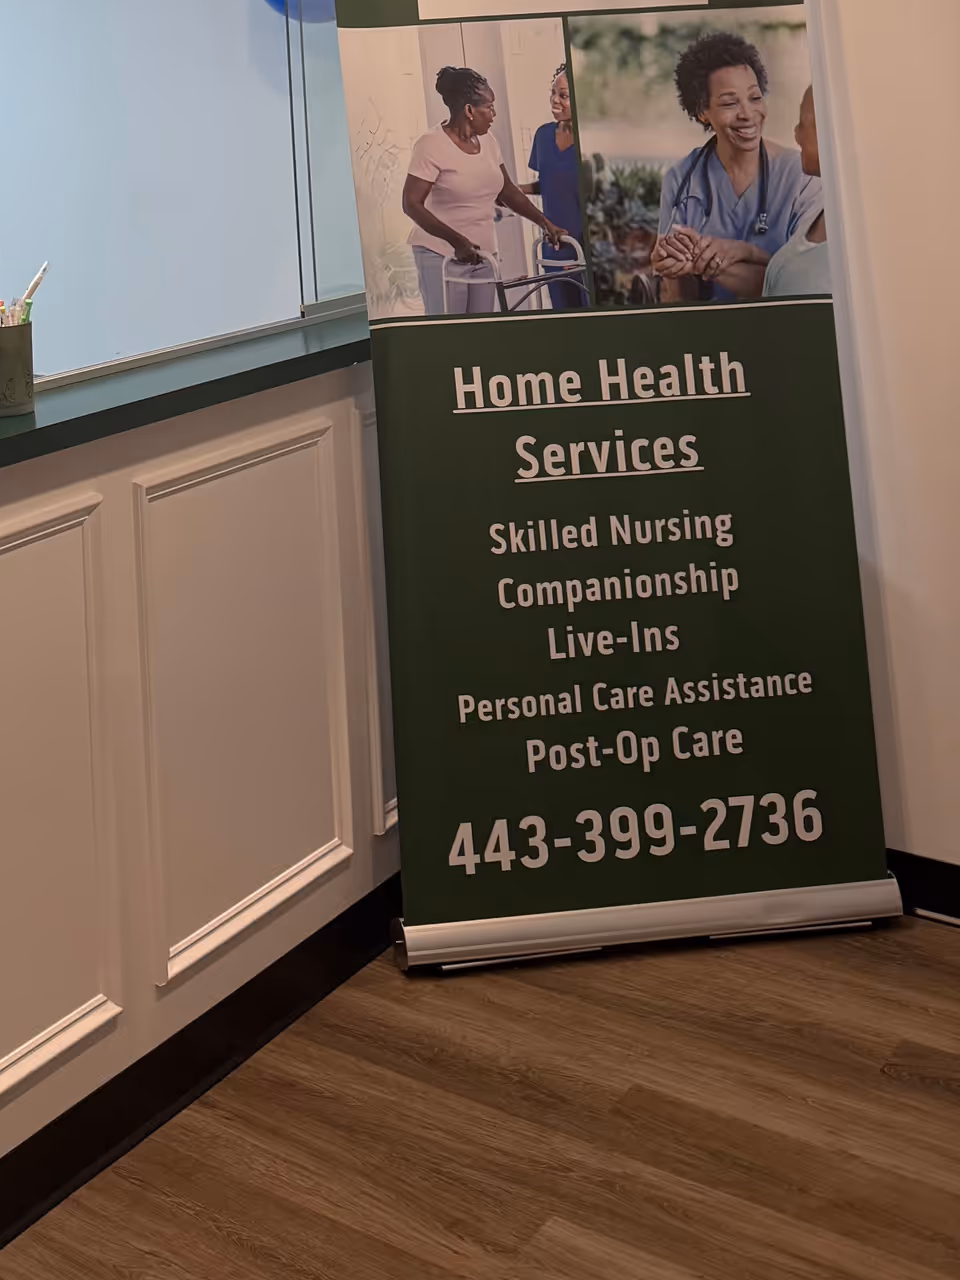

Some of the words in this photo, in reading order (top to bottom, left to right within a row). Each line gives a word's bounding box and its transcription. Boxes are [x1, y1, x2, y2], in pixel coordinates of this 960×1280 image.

[453, 366, 583, 409] Home
[599, 352, 746, 401] Health
[516, 430, 700, 478] Services
[490, 517, 598, 554] Skilled
[610, 510, 733, 546] Nursing
[498, 562, 739, 612] Companionship
[548, 622, 680, 659] Live-Ins
[458, 685, 582, 722] Personal
[593, 682, 654, 711] Care
[665, 672, 812, 705] Assistance
[526, 730, 660, 772] Post-Op
[673, 727, 744, 760] Care
[449, 790, 823, 875] 443-399-2736
